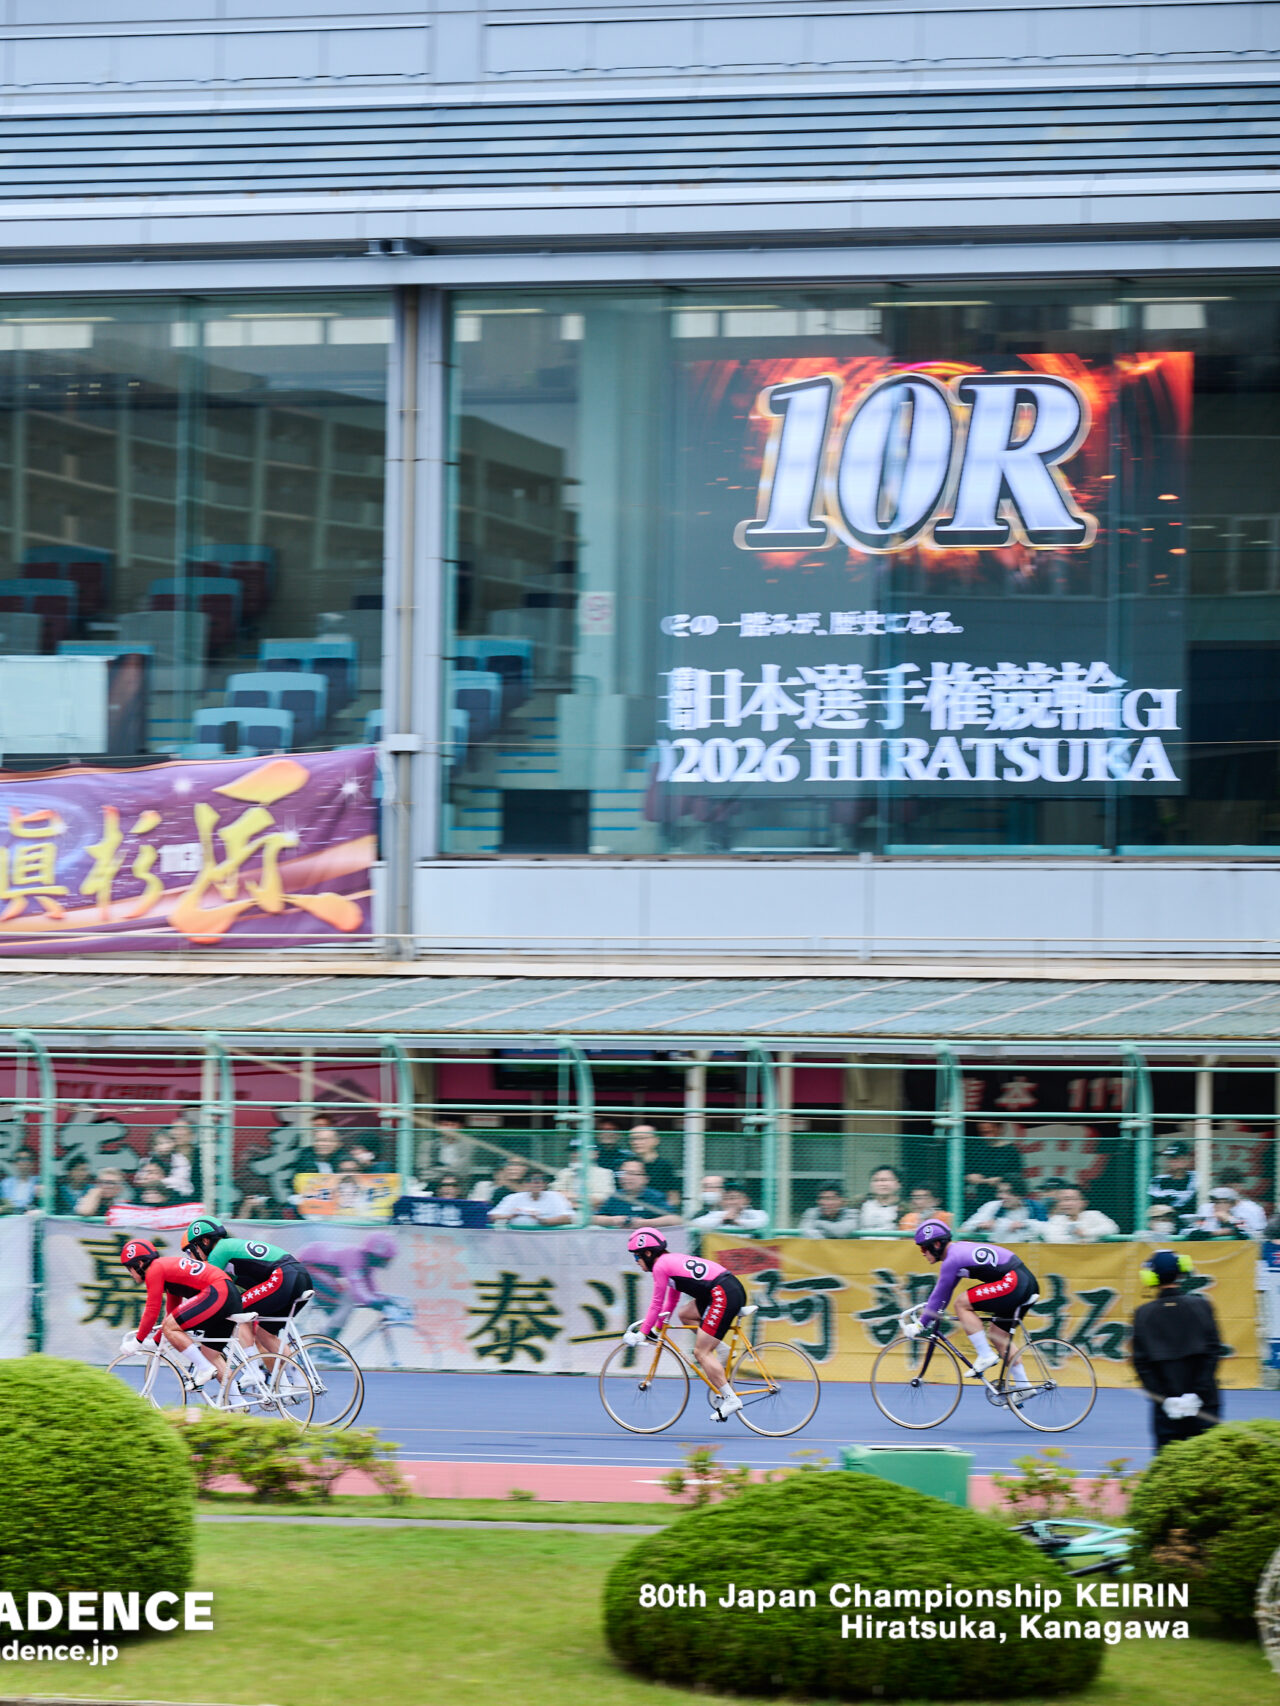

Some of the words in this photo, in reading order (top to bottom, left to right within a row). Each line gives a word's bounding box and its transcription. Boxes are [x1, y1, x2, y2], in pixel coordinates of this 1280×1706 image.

[735, 372, 1096, 551] 10R
[668, 737, 801, 783] 2026
[804, 736, 1182, 783] HIRATSUKA
[192, 1222, 202, 1236] 6
[922, 1225, 934, 1240] 9
[126, 1243, 137, 1258] 3
[245, 1240, 271, 1260] 6
[972, 1246, 999, 1268] 9
[179, 1256, 206, 1276] 3
[684, 1259, 709, 1280] 8
